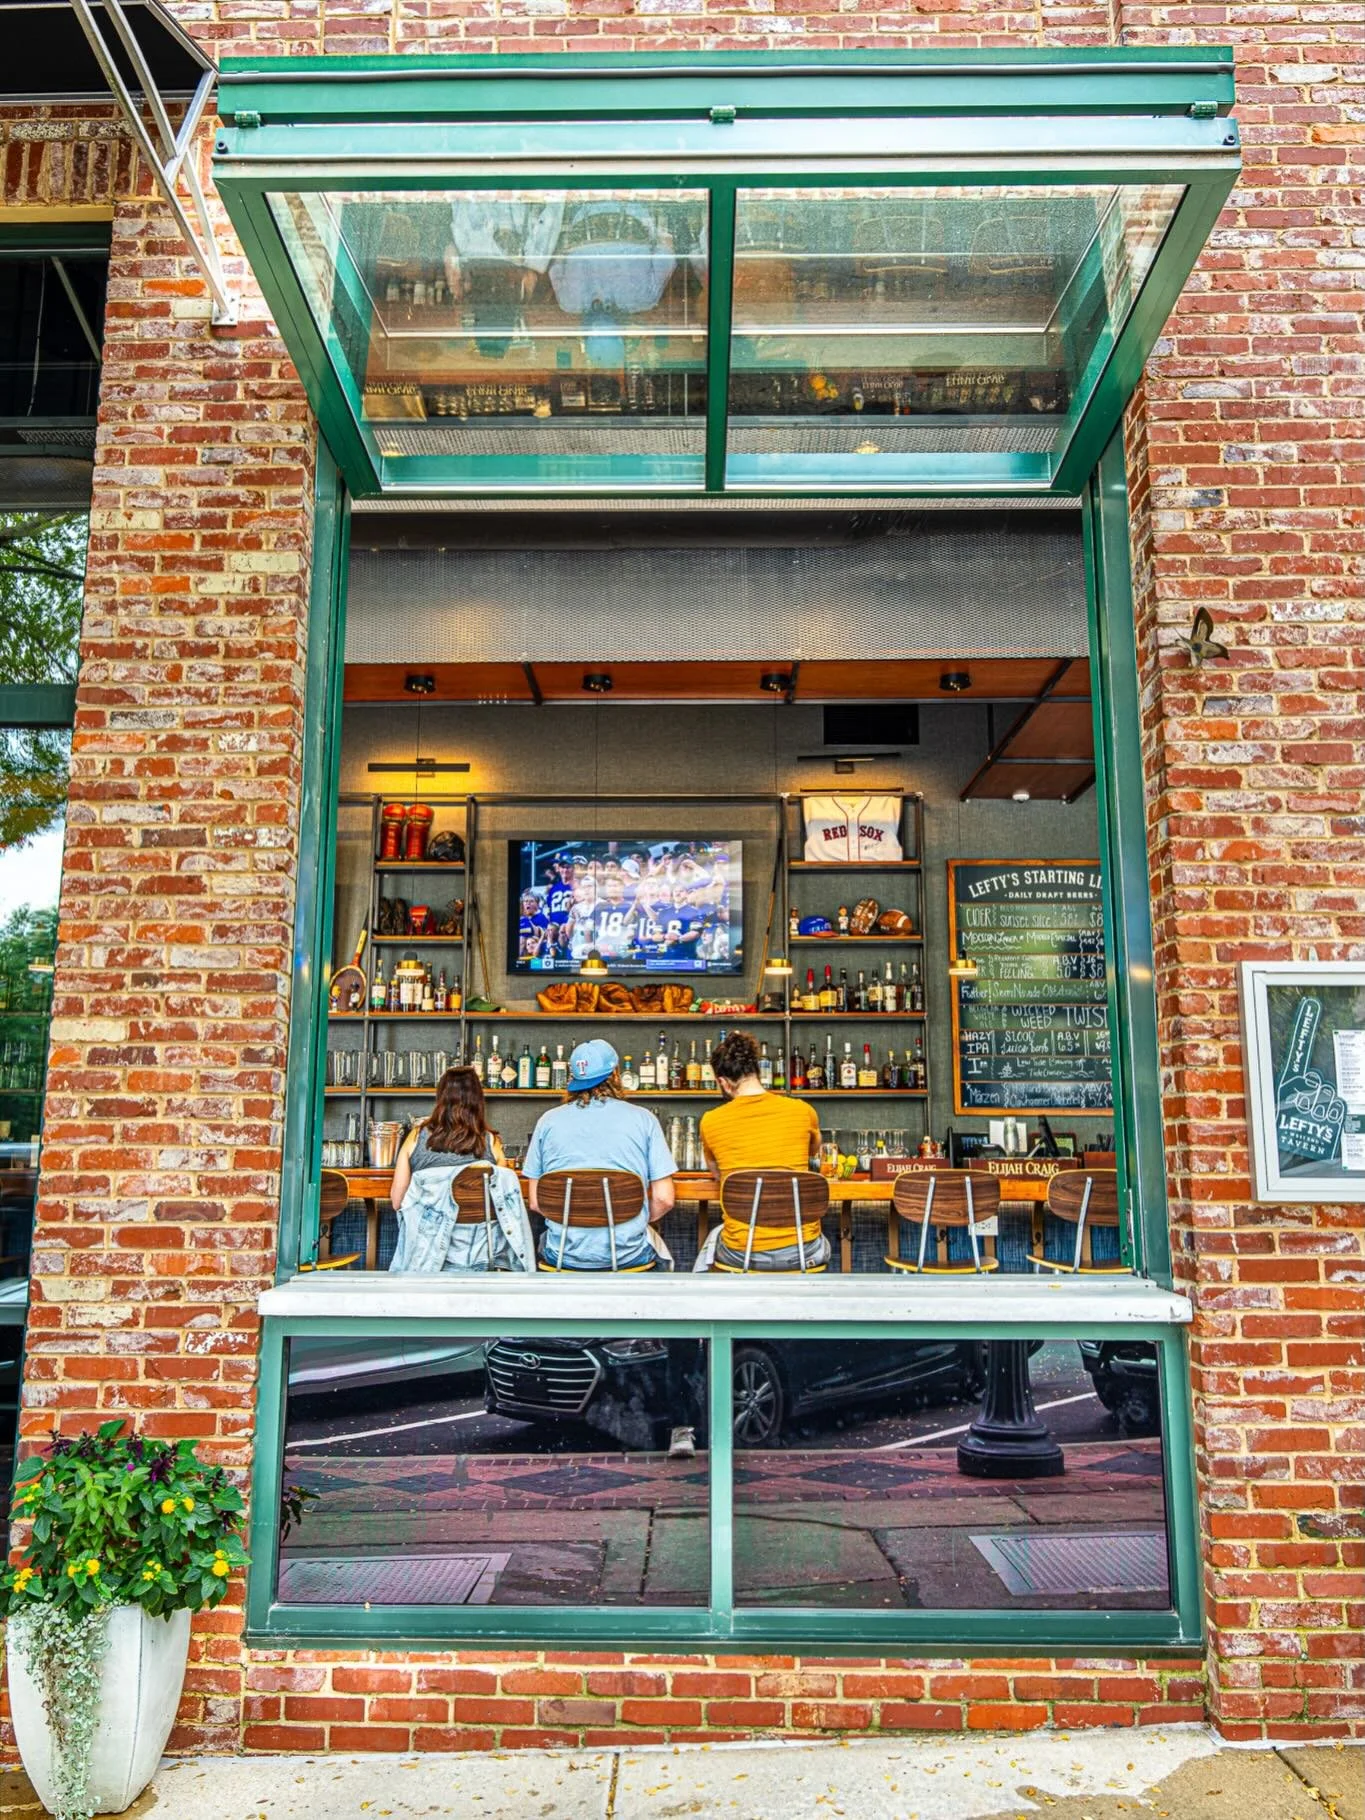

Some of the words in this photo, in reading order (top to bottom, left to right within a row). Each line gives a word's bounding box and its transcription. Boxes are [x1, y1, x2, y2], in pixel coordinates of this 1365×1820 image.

[822, 824, 848, 842] RED
[859, 825, 884, 842] SOX
[968, 873, 1020, 898] LEFTY'S
[1024, 870, 1084, 886] STARTING
[600, 911, 624, 937] 18
[966, 908, 991, 928] CIDER
[1011, 1005, 1056, 1016] WICKED
[1020, 1017, 1052, 1029] WEED
[964, 1032, 991, 1041] HAZY
[966, 1043, 989, 1054] IPA
[576, 1060, 588, 1076] T
[1279, 1114, 1334, 1143] LEFTY'S
[1281, 1136, 1325, 1155] TAVERN
[988, 1161, 1023, 1176] ELIJAH
[1025, 1161, 1059, 1177] CRAIG
